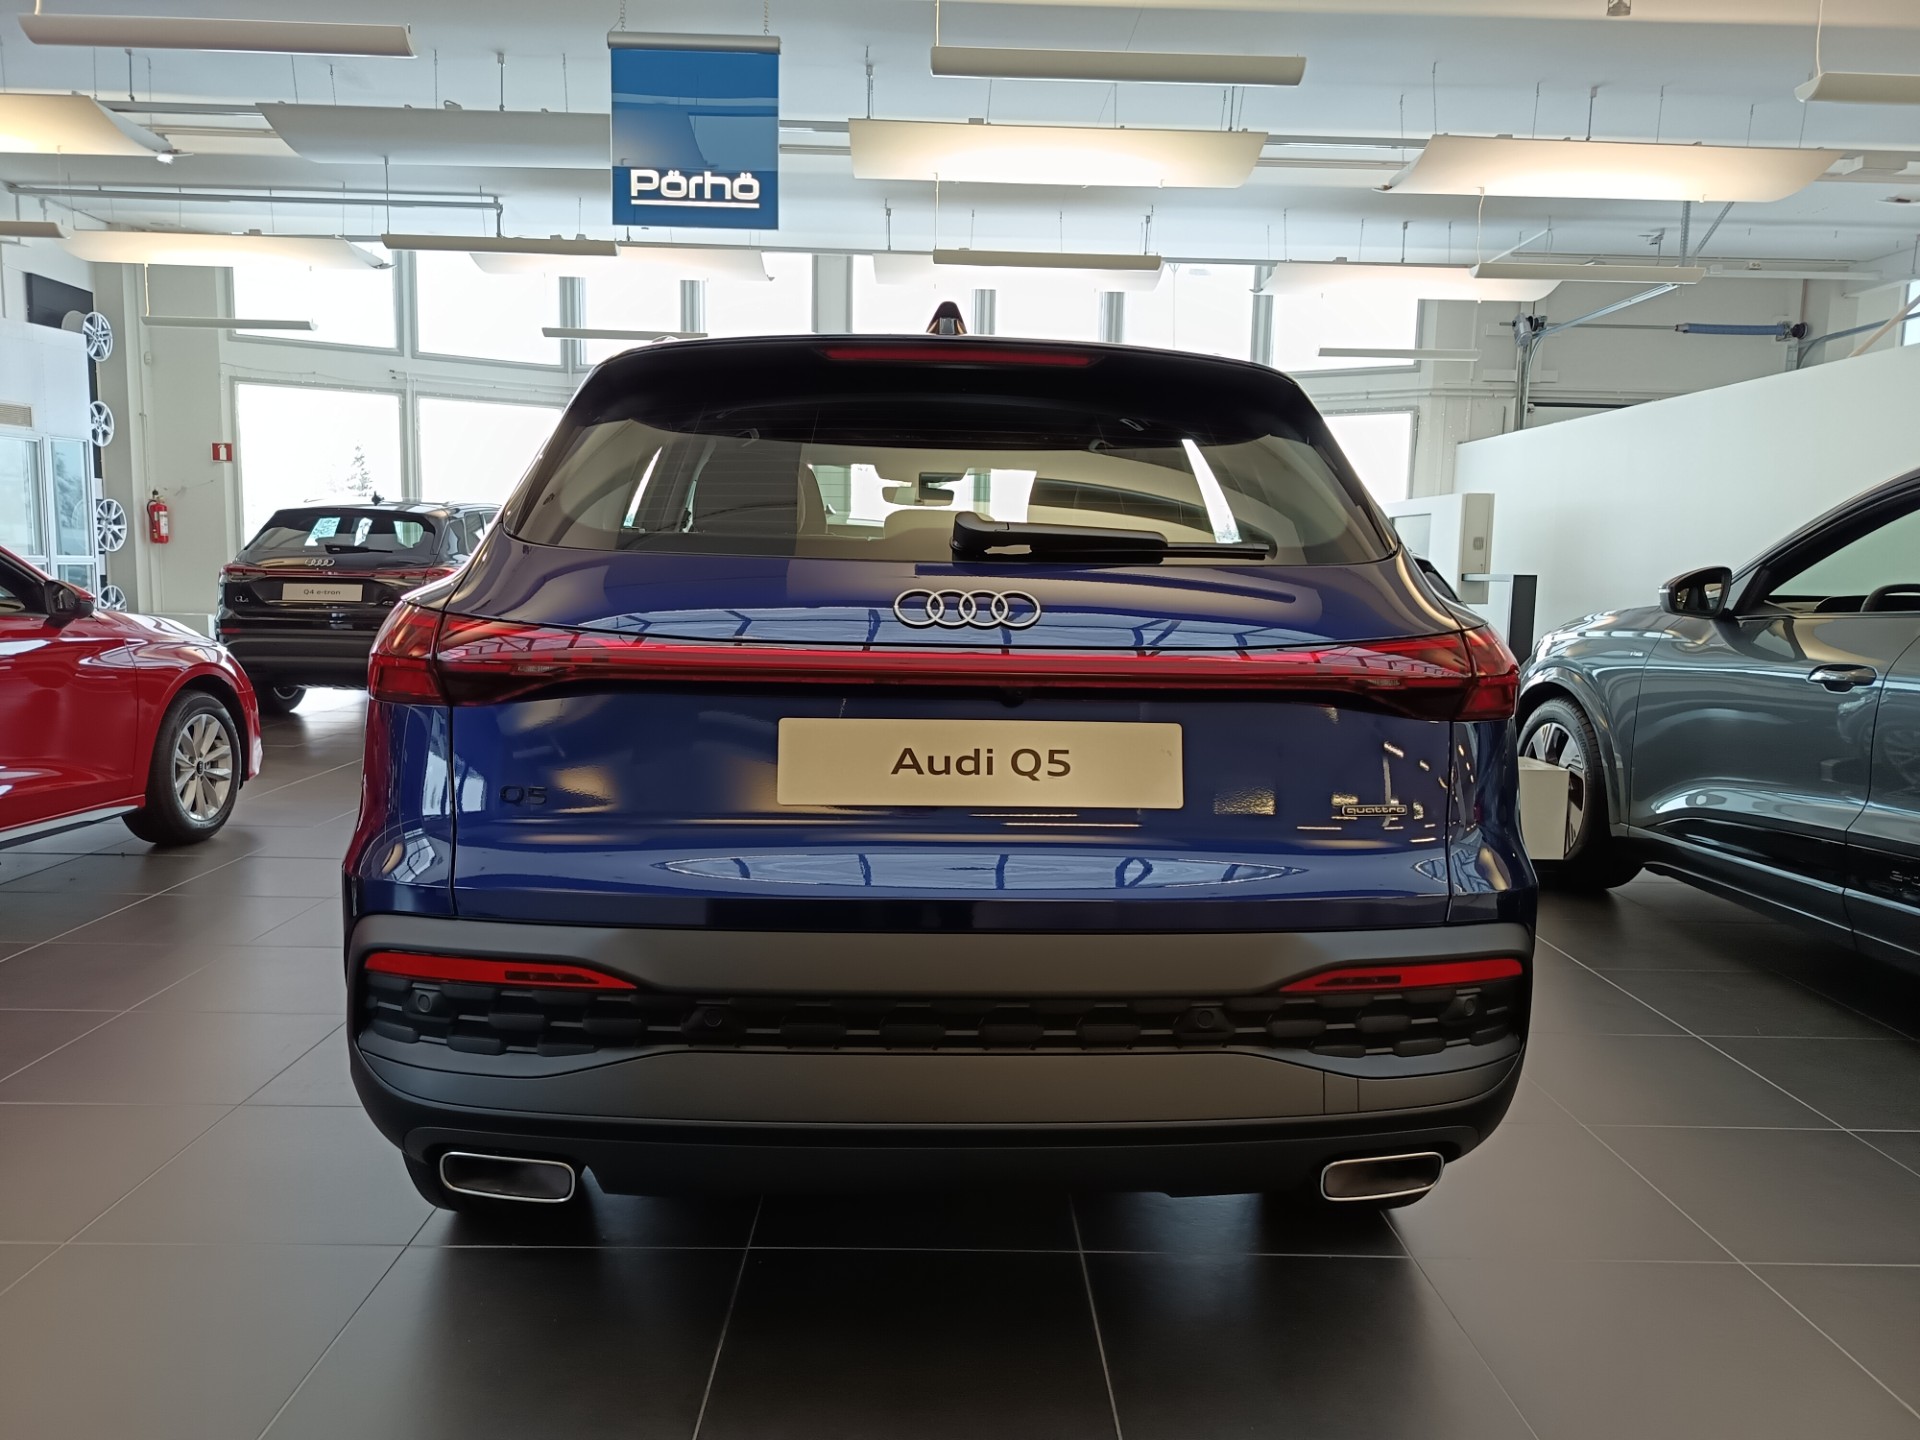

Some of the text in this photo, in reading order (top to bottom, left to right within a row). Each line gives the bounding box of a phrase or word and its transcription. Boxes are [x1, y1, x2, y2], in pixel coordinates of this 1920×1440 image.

[630, 169, 760, 200] Pörhö
[890, 748, 1072, 781] Audi Q5
[500, 785, 547, 807] Q5
[1346, 806, 1405, 815] quattro
